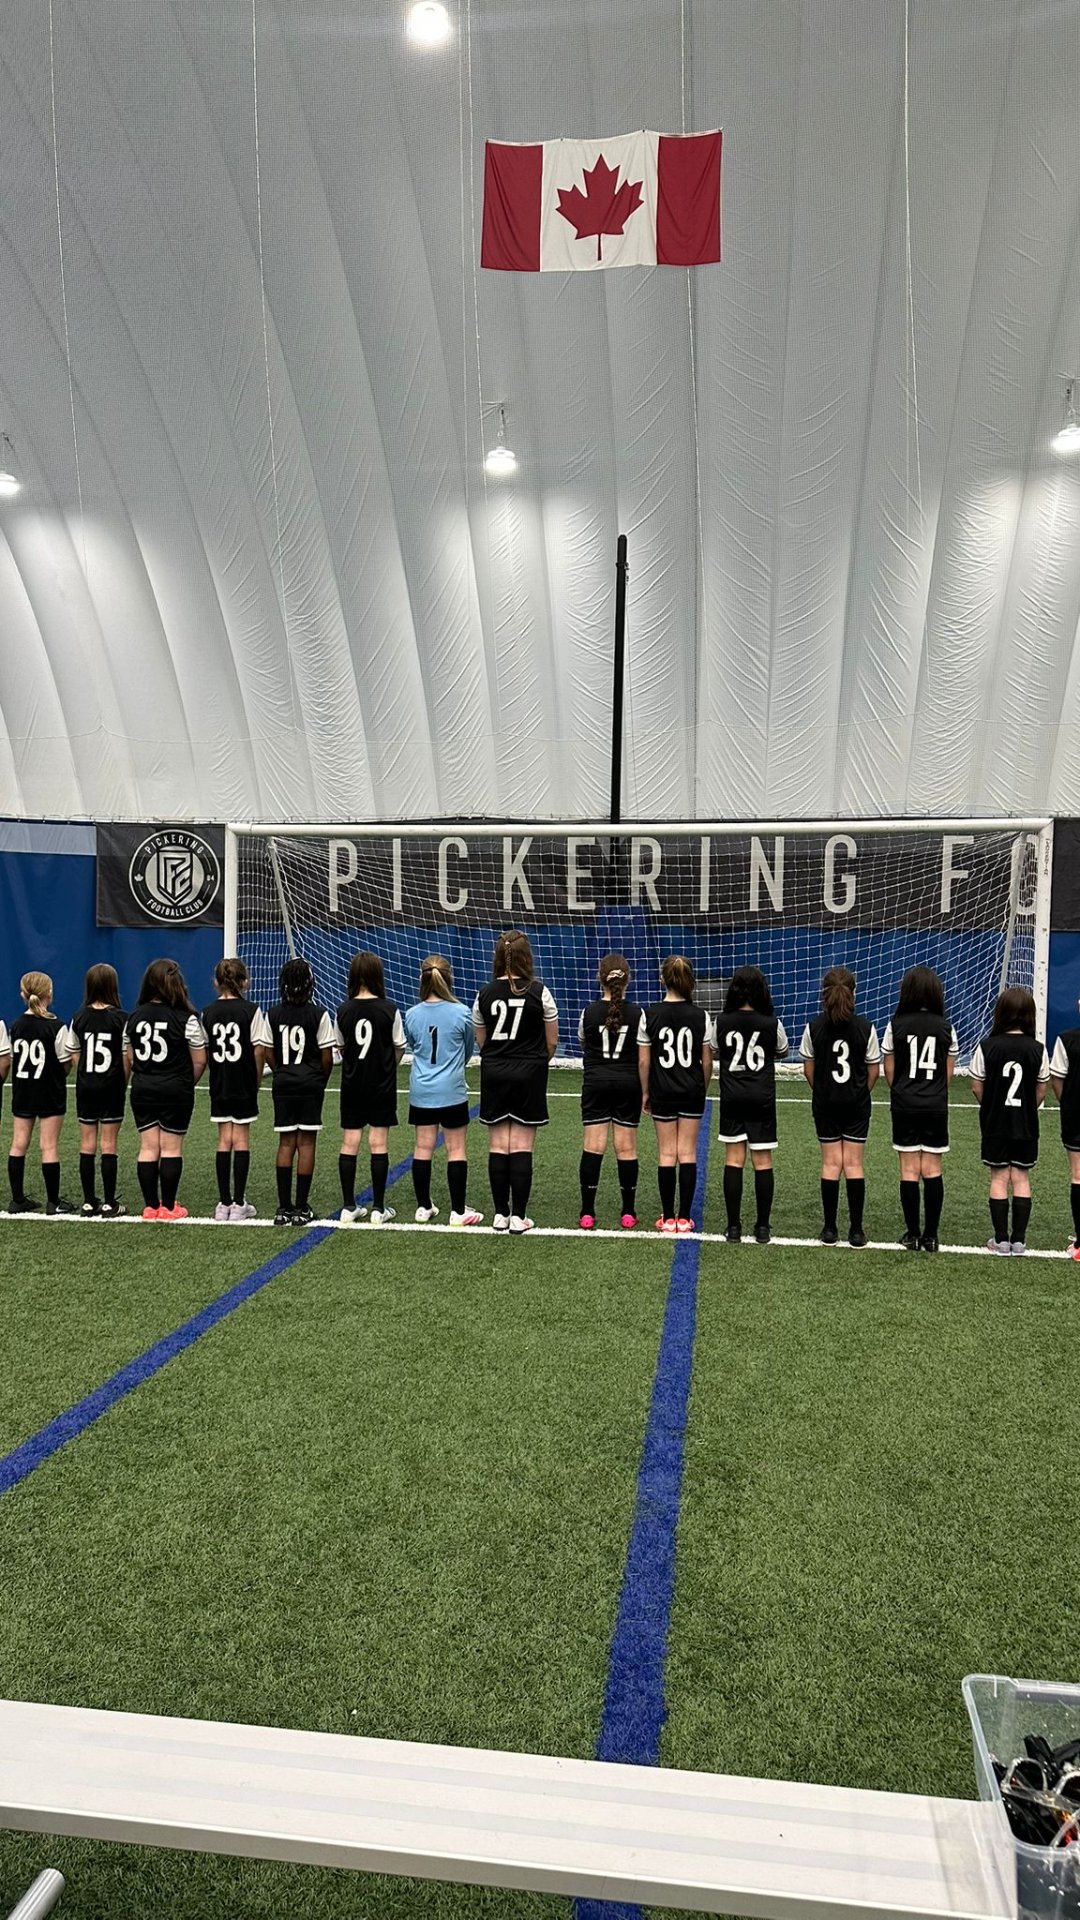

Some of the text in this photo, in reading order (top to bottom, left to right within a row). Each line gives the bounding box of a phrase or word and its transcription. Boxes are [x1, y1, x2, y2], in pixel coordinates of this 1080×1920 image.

[144, 834, 204, 855] PICKERING
[328, 834, 857, 913] PICKERING
[146, 899, 204, 917] FOOTBALL CLUB
[355, 1018, 373, 1060] 9
[490, 999, 526, 1041] 27
[13, 1038, 46, 1080] 29
[84, 1032, 112, 1073] 15
[135, 1020, 169, 1063] 35
[212, 1022, 242, 1063] 33
[279, 1024, 306, 1065] 19
[428, 1025, 439, 1065] 1
[598, 1025, 629, 1059] 17
[658, 1026, 693, 1069] 30
[725, 1030, 765, 1072] 26
[832, 1039, 851, 1084] 3
[906, 1034, 938, 1080] 14
[1002, 1060, 1024, 1107] 2
